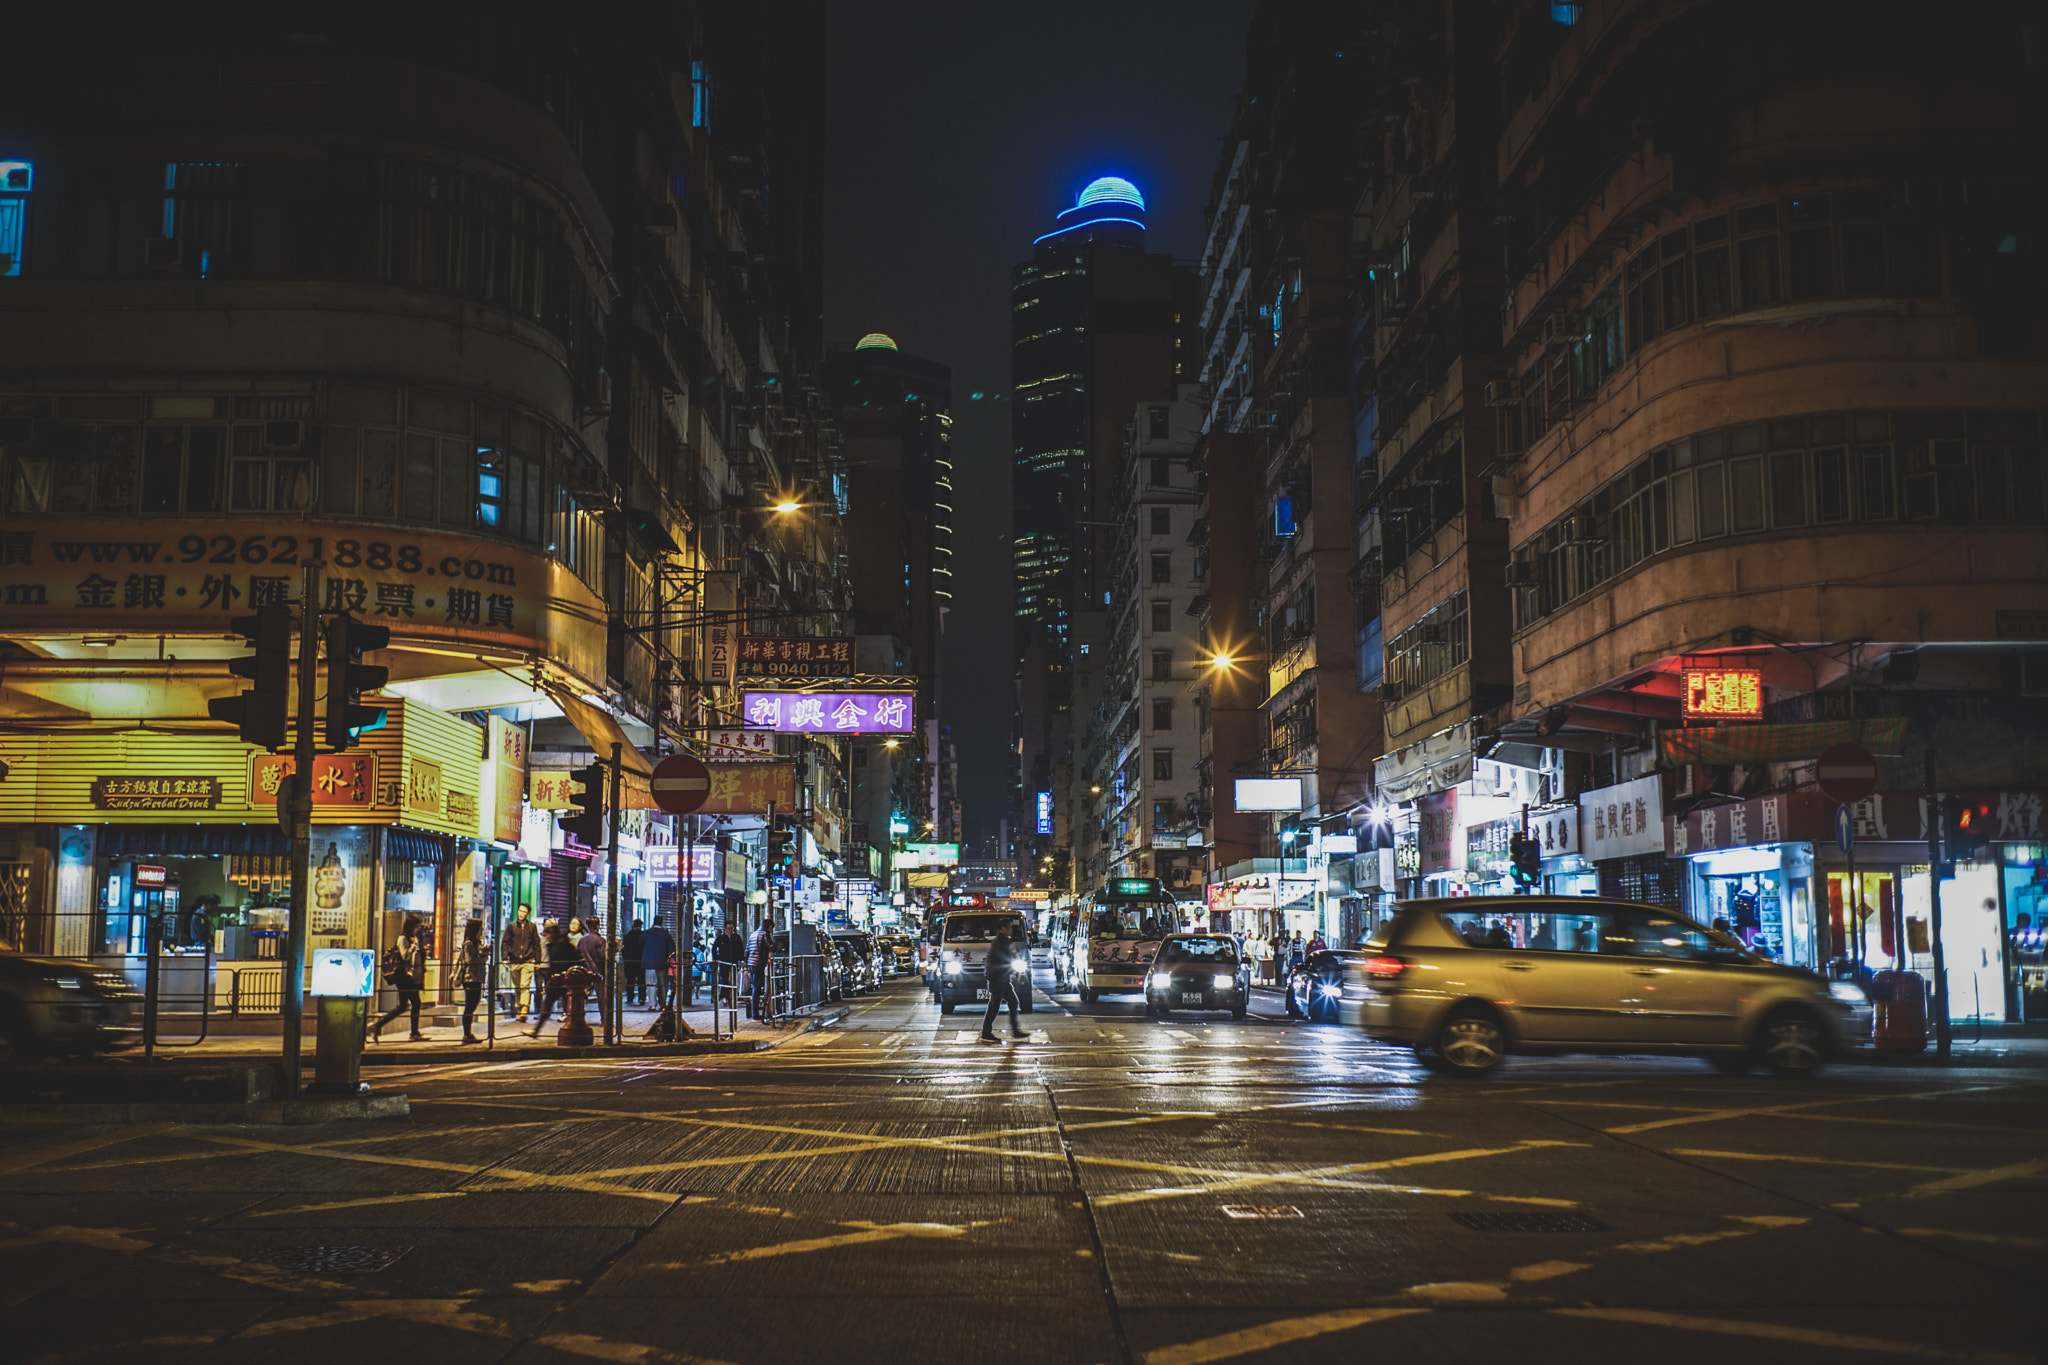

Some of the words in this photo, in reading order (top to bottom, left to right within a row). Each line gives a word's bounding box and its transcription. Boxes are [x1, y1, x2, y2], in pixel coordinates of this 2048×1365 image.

[49, 534, 516, 587] www.92621888.com
[742, 641, 850, 661] 新華電視工程
[768, 662, 809, 675] 9040
[813, 663, 850, 675] 1124
[750, 697, 907, 729] 利興金行
[260, 763, 350, 796] 葛水
[535, 778, 587, 803] 新華
